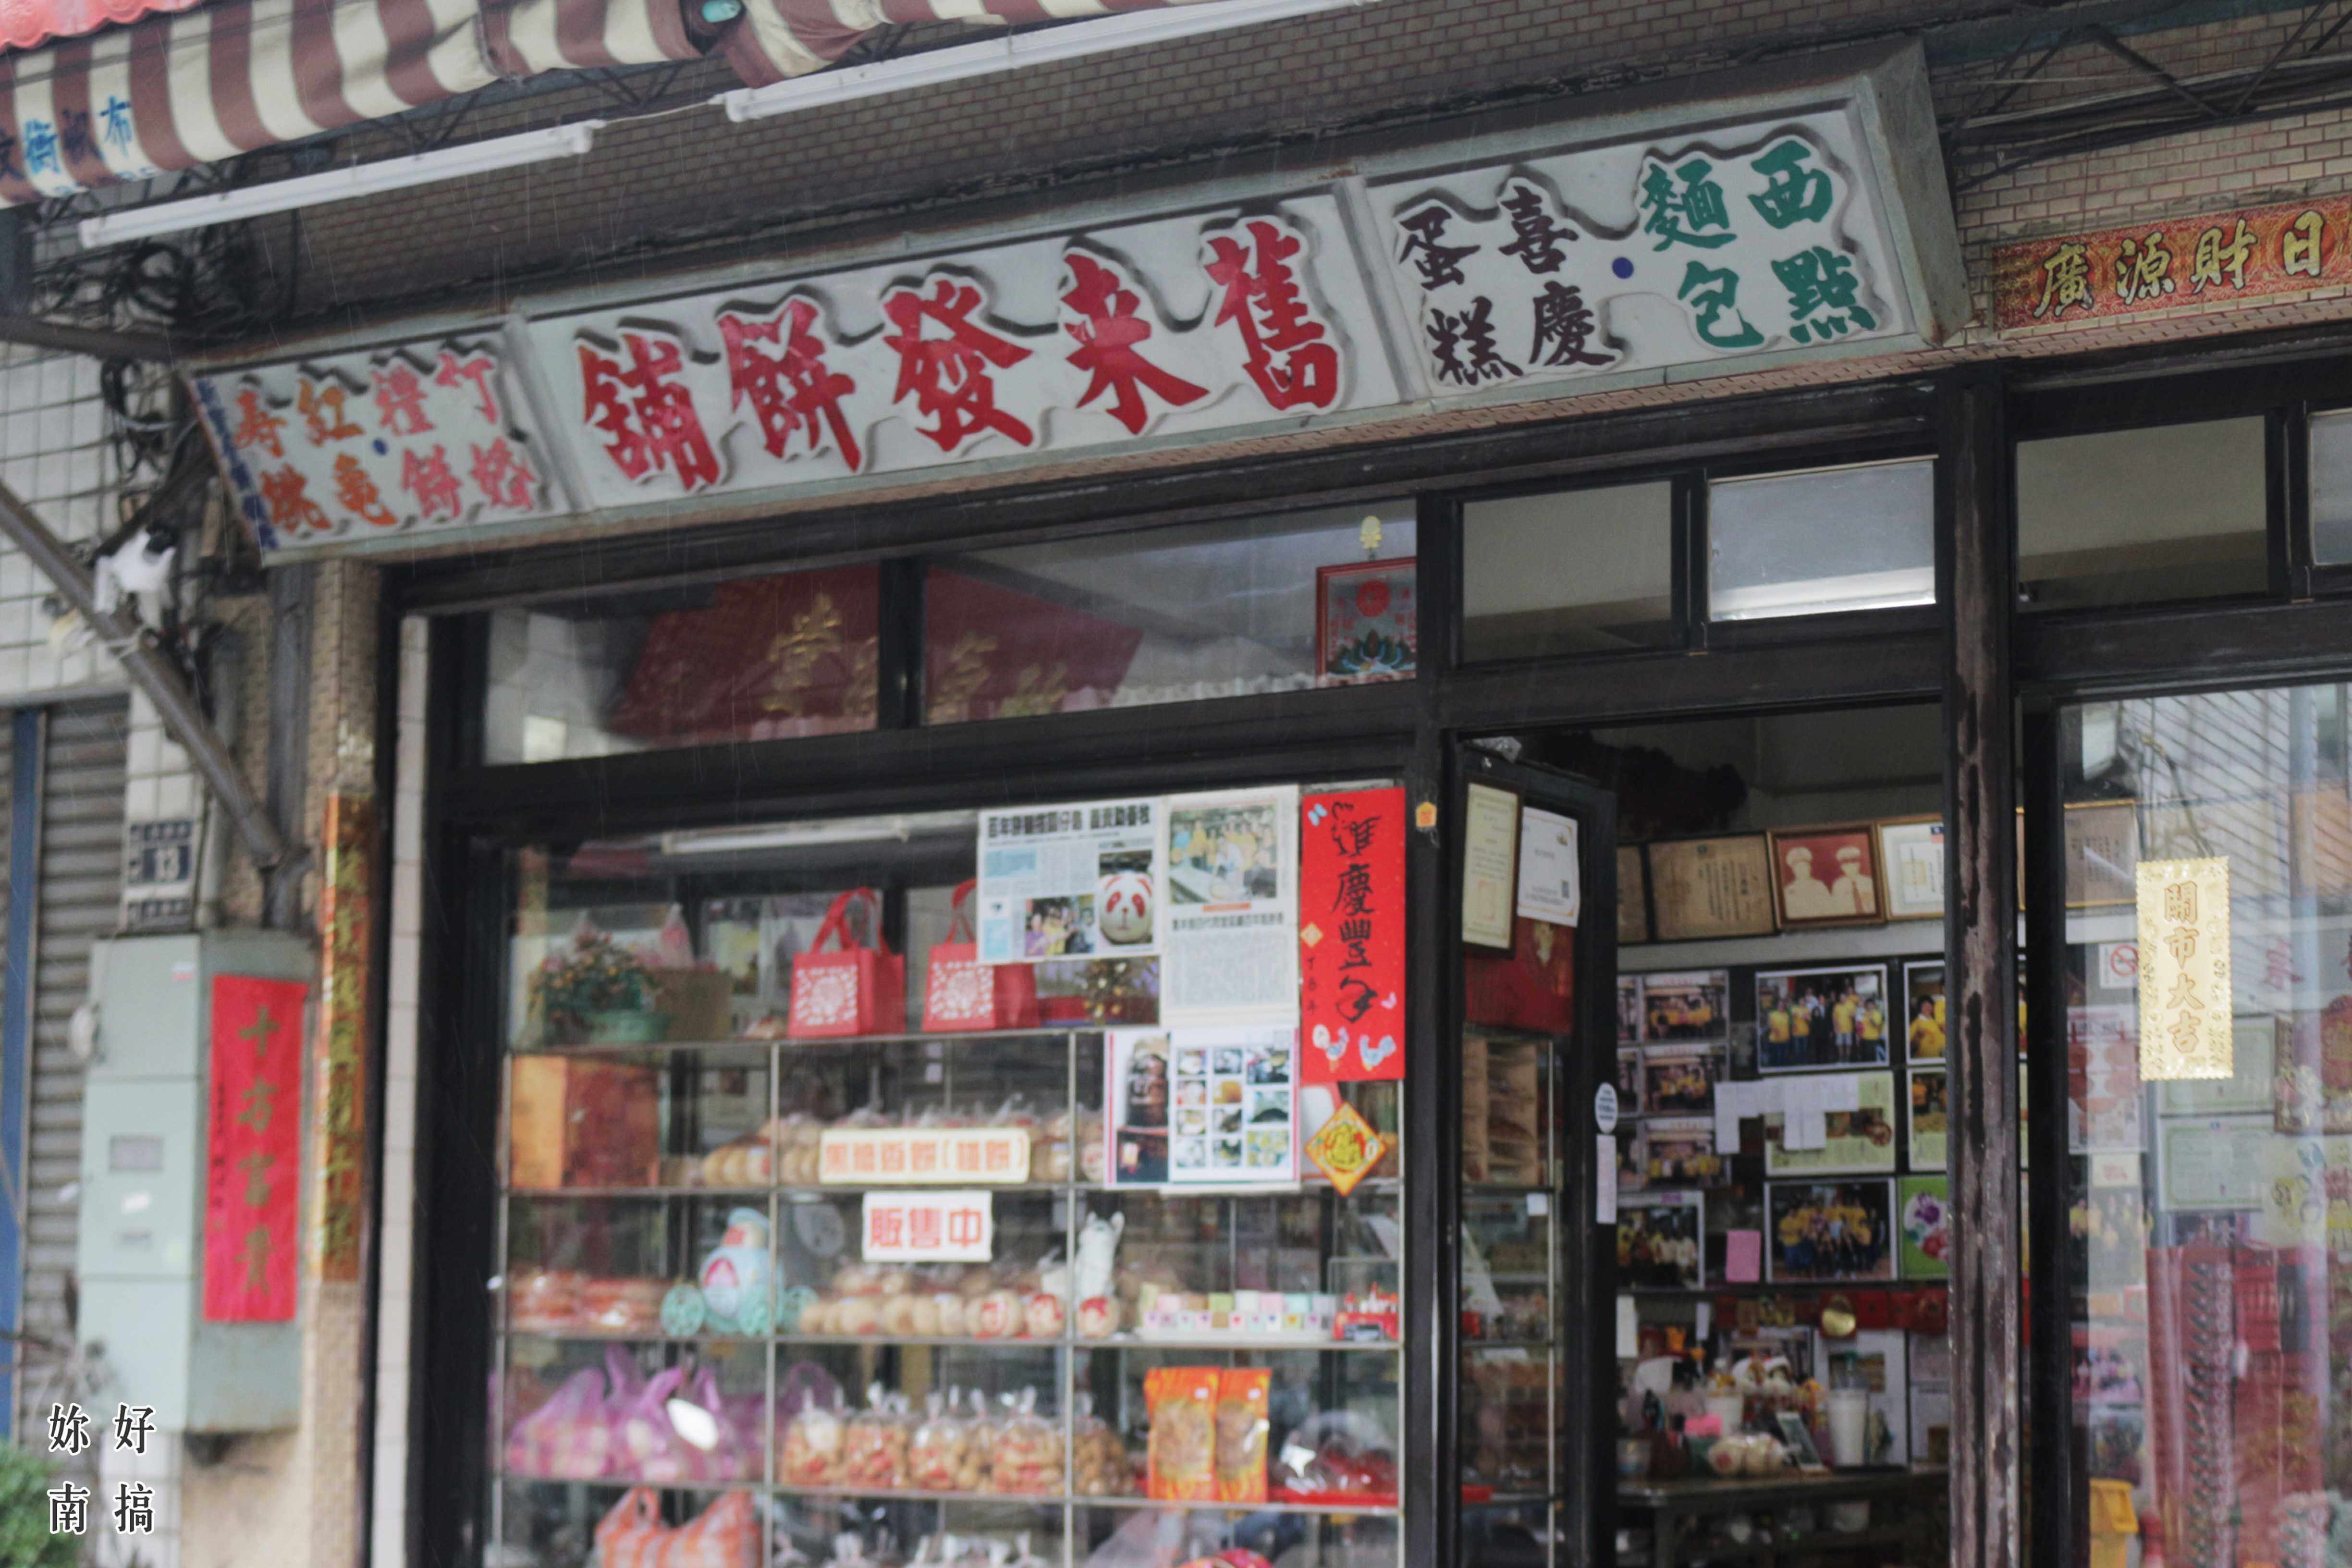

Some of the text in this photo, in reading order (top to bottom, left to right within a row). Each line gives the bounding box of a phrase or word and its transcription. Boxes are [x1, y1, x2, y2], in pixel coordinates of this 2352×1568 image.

[1398, 206, 1523, 386] 蛋糕
[1499, 185, 1616, 368] 喜慶
[1639, 157, 1764, 349] 麵包
[1747, 139, 1877, 344] 西點
[2163, 881, 2205, 1054] 開市大吉
[870, 1207, 983, 1249] 販售中
